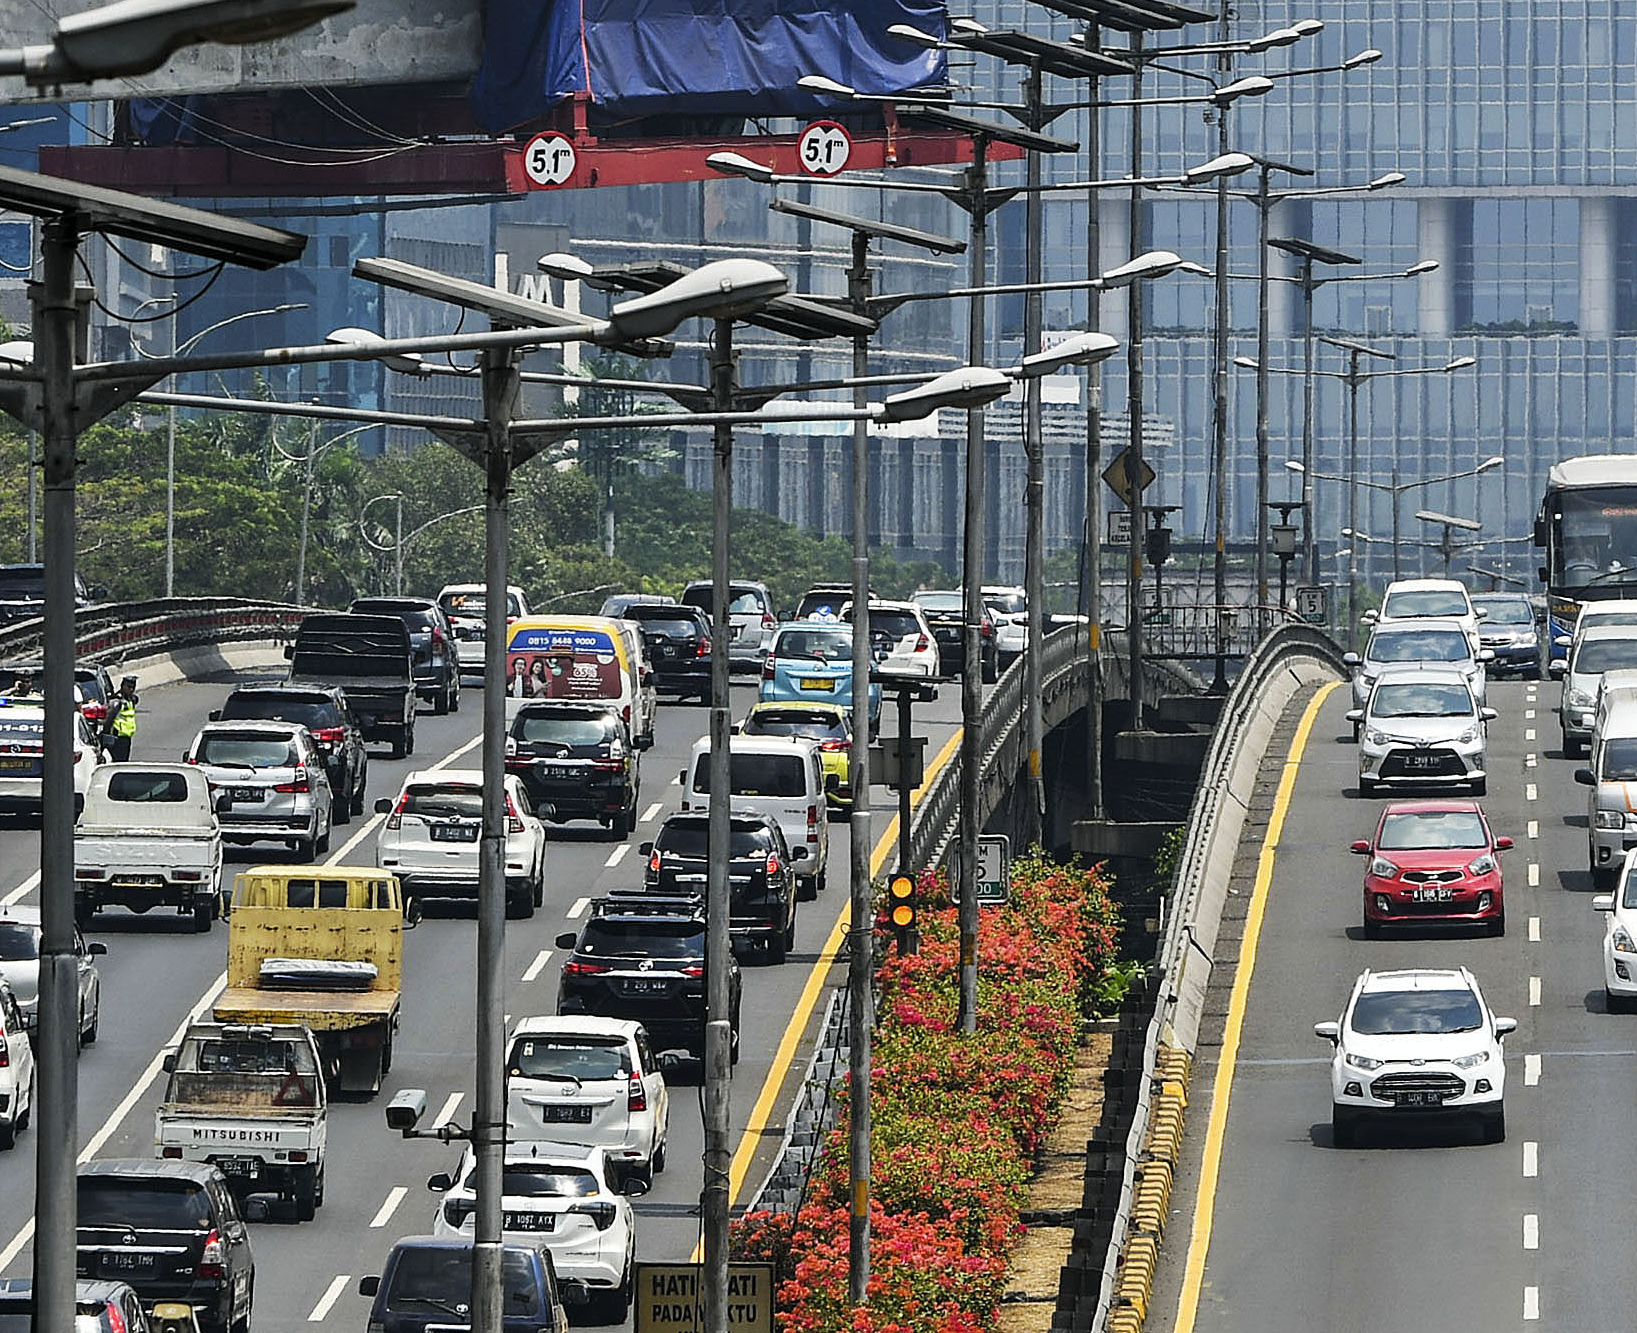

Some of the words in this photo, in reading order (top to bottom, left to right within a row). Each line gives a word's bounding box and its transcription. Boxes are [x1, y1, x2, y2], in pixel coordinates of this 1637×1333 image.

[1308, 600, 1317, 613] 5
[192, 1128, 281, 1143] MITSUBISHI
[651, 1273, 696, 1297] HATI
[726, 1273, 757, 1297] ATI
[652, 1303, 694, 1323] PADA
